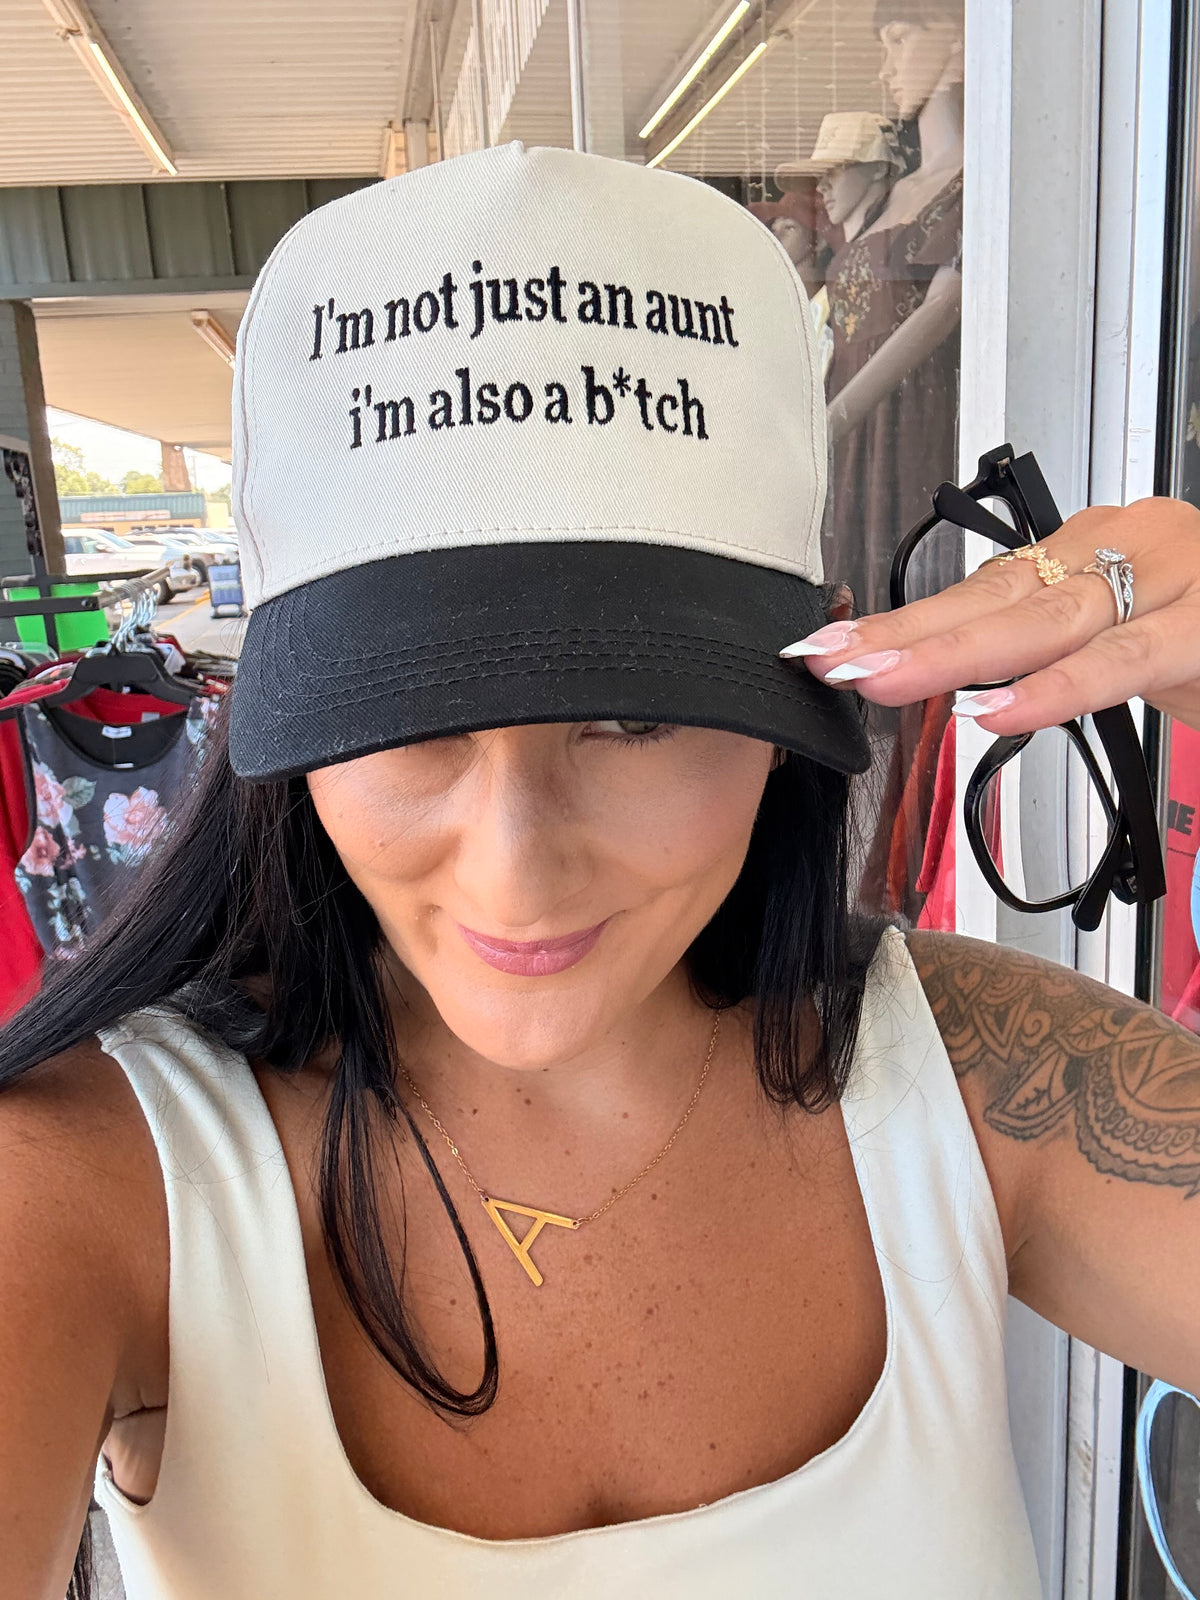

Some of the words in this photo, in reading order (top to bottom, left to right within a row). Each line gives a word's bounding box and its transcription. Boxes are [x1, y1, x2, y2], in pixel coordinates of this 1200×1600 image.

[309, 297, 376, 362] I'm
[383, 272, 459, 343] not
[469, 260, 568, 340] just
[577, 280, 638, 330] an
[645, 289, 740, 348] aunt
[349, 384, 417, 450] i'm
[428, 367, 534, 431] also
[544, 382, 573, 425] a
